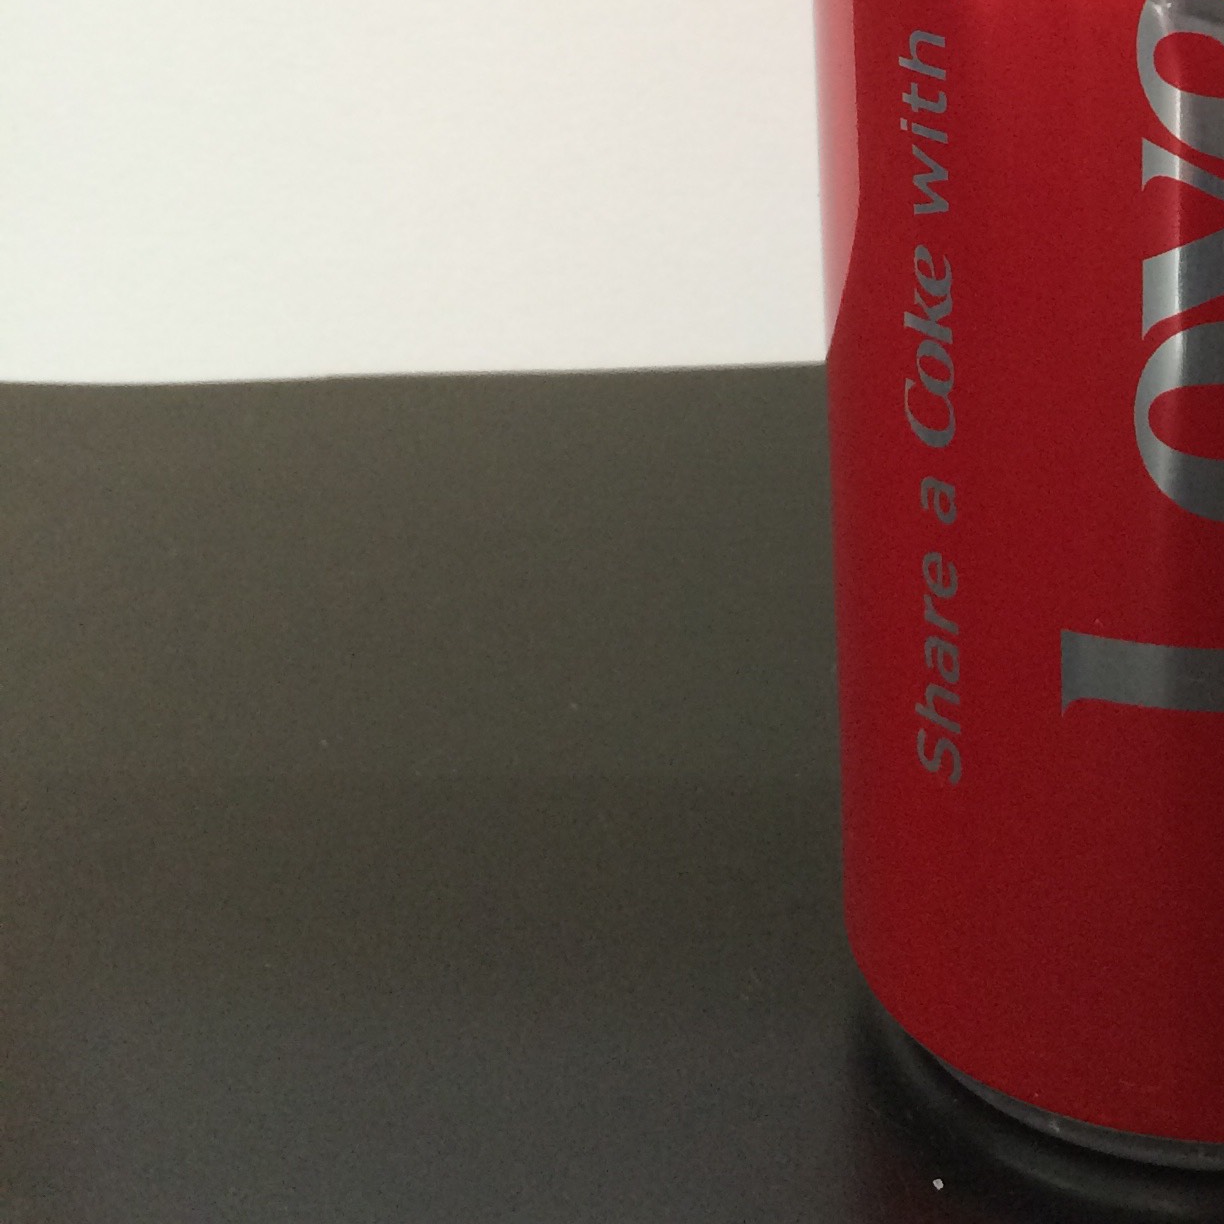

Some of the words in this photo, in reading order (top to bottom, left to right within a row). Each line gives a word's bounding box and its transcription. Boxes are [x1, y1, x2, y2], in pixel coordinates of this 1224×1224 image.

[899, 29, 950, 214] with
[903, 244, 957, 448] Coke
[920, 477, 957, 524] a
[914, 551, 962, 785] Share
